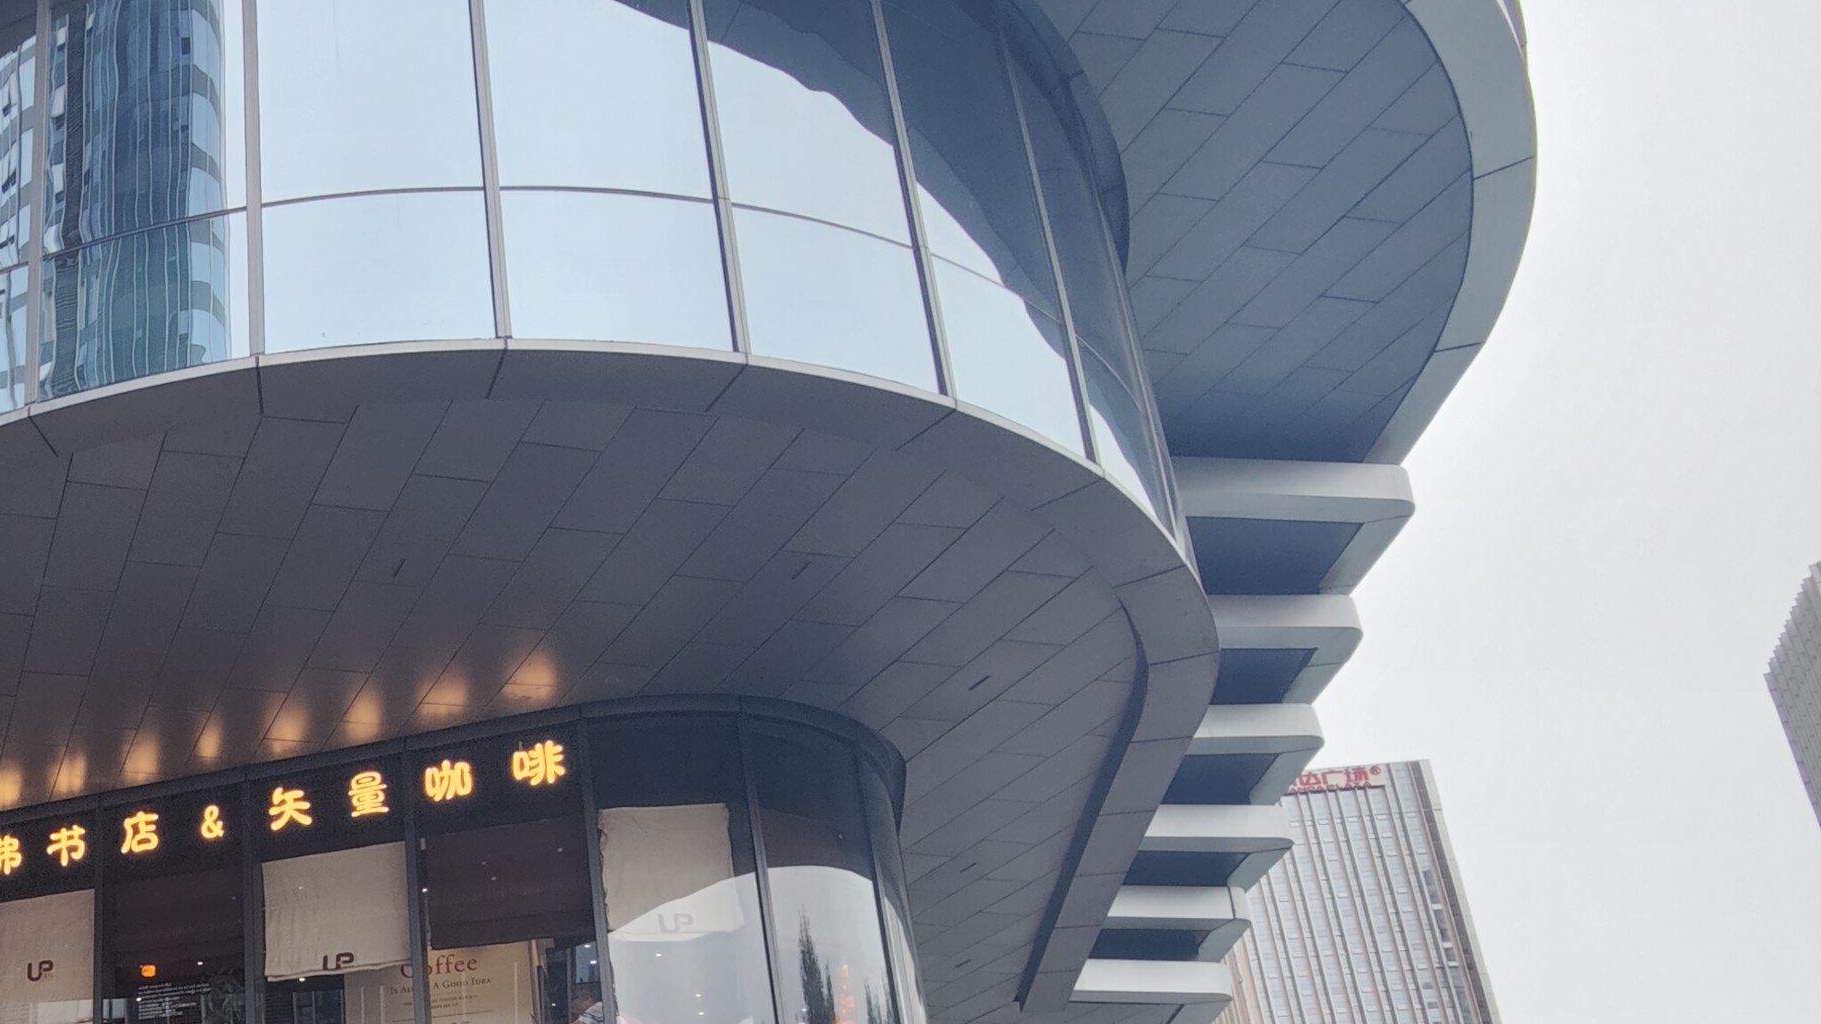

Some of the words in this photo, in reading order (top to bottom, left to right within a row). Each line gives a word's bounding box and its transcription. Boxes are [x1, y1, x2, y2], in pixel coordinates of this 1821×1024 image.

[200, 804, 226, 840] &
[269, 740, 567, 831] 矢量咖啡
[27, 959, 55, 982] UP
[322, 951, 355, 972] UP
